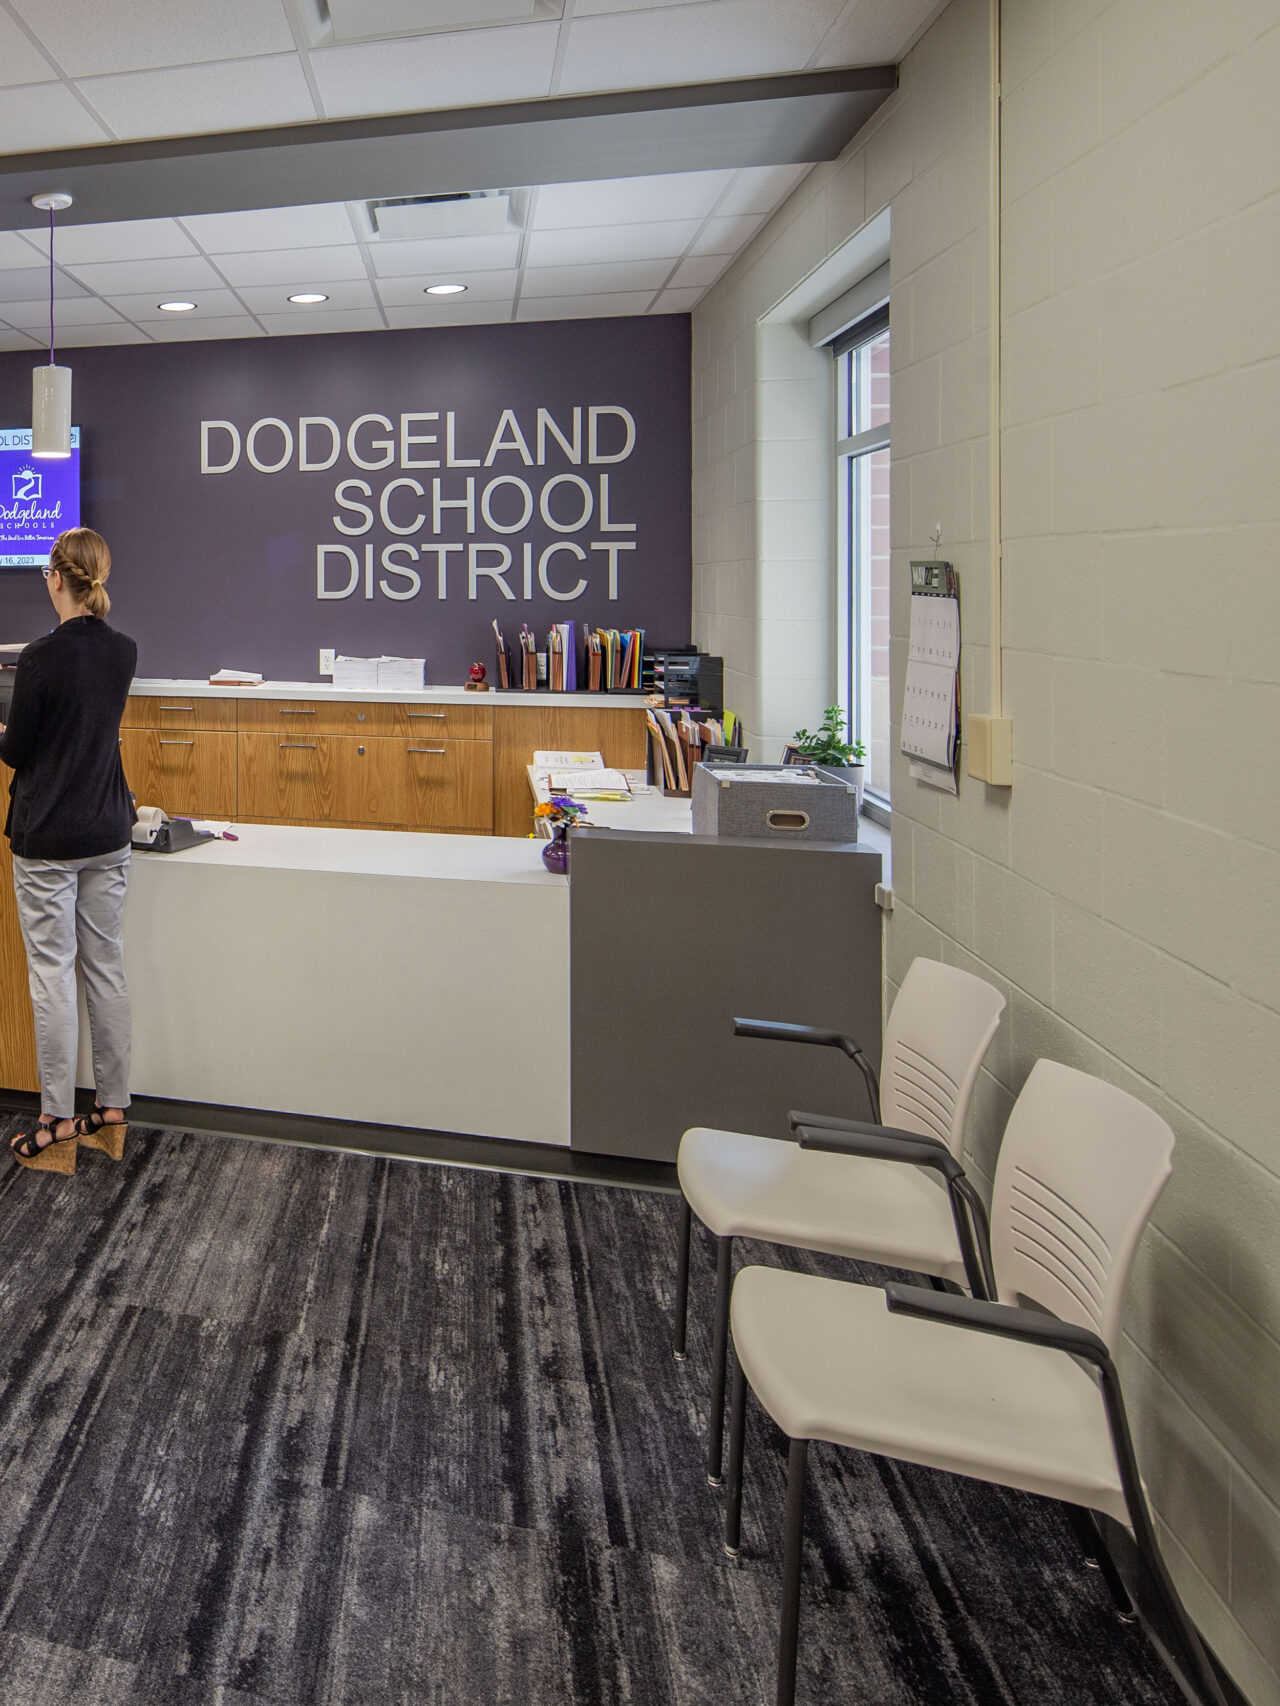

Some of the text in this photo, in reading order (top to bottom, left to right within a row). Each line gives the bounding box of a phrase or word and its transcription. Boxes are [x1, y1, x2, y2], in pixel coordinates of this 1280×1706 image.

[200, 405, 637, 475] DODGELAND
[332, 473, 637, 536] SCHOOL
[17, 556, 35, 565] 2023
[316, 540, 637, 601] DISTRICT
[912, 566, 926, 585] MAY
